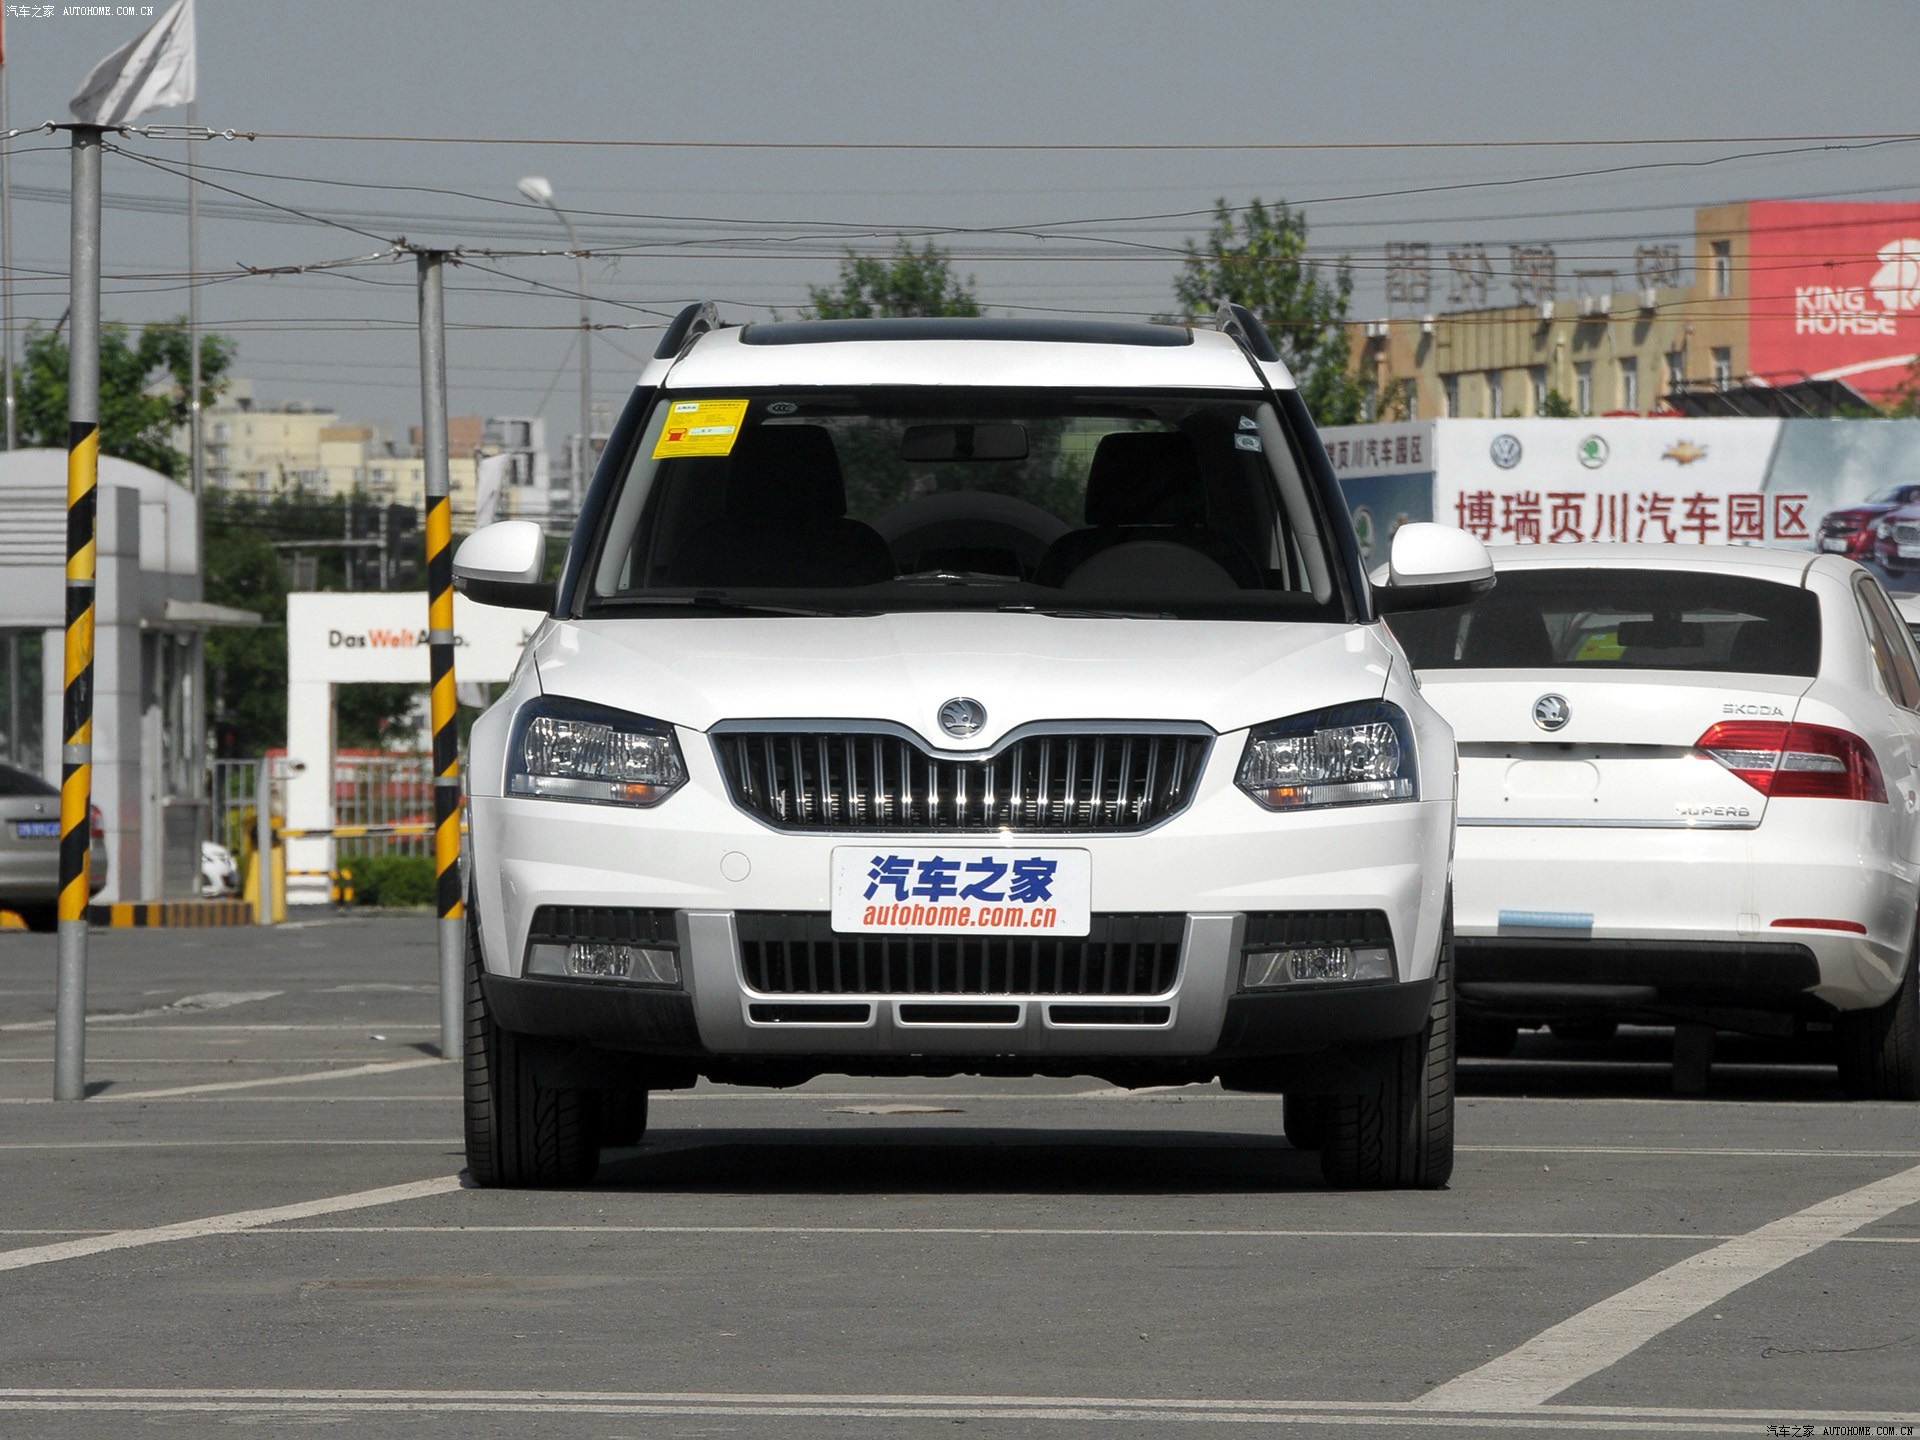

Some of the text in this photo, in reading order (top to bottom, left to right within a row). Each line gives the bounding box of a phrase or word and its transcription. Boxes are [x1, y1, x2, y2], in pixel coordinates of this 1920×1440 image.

[1795, 286, 1865, 311] KING
[1795, 310, 1897, 335] HORSE
[1456, 490, 1810, 544] 博瑞页川汽车园区
[863, 855, 1058, 903] 汽车之家
[862, 903, 1058, 928] autohome.com.cn
